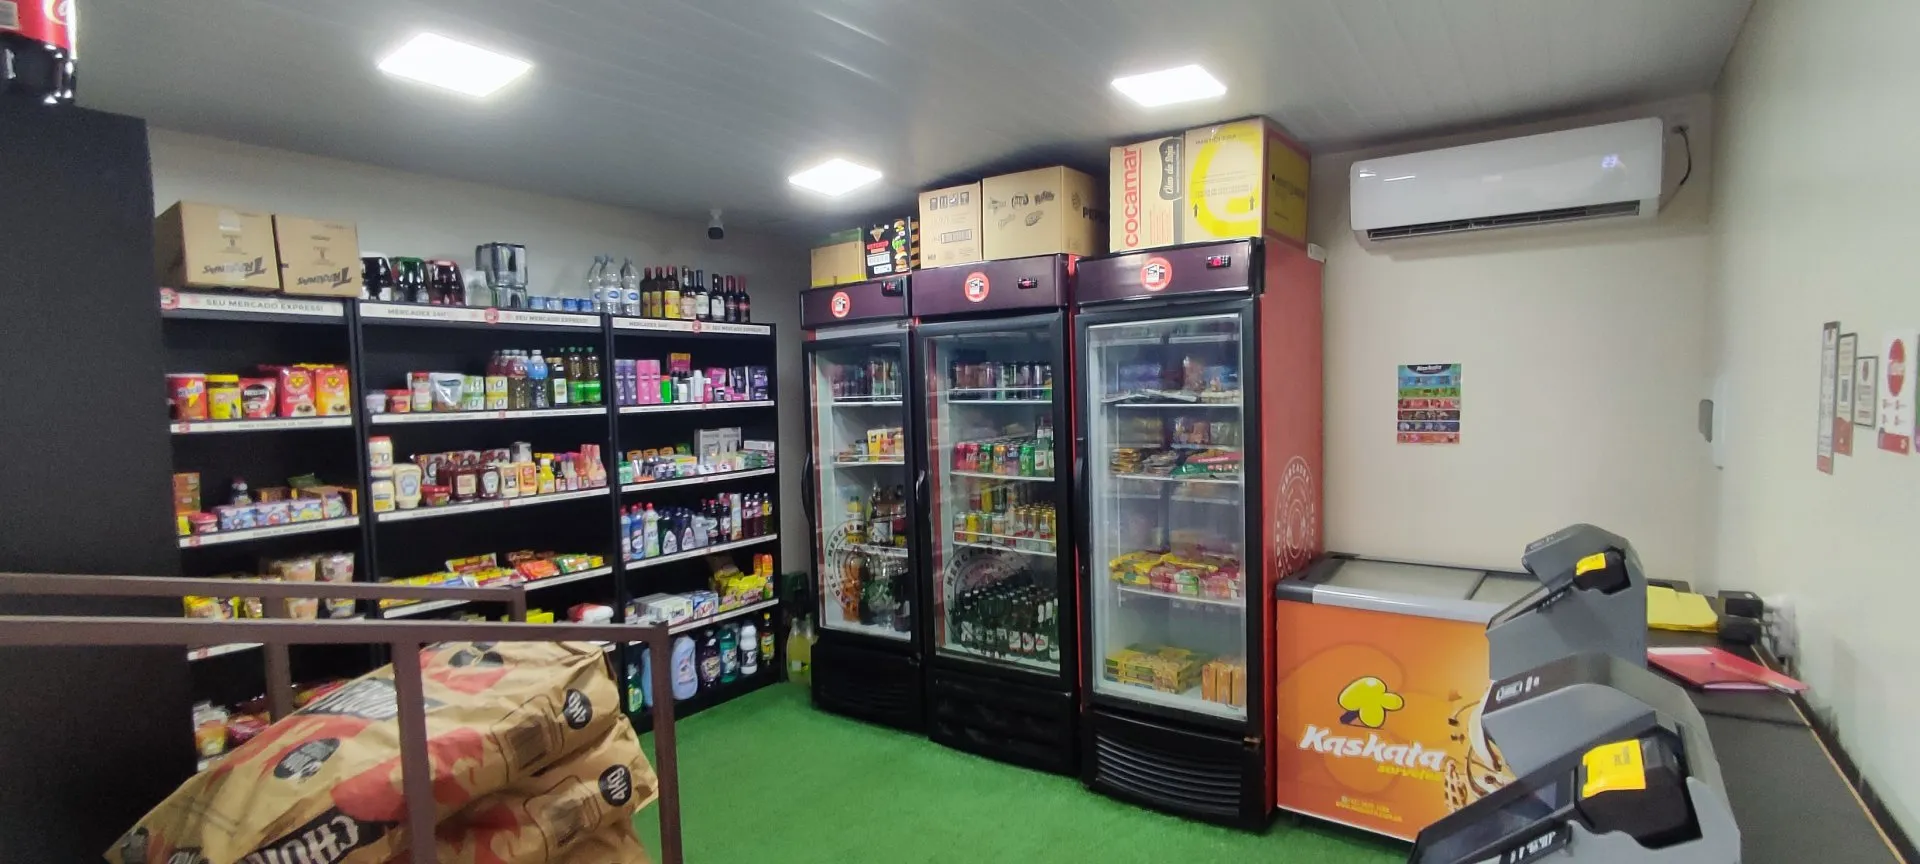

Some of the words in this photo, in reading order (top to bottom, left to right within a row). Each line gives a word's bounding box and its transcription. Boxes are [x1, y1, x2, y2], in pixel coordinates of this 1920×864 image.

[1165, 145, 1175, 163] Soja
[1123, 147, 1139, 248] cocamar
[229, 300, 278, 310] MERCADO
[1299, 723, 1447, 772] Kaskata
[606, 766, 626, 800] 4KG
